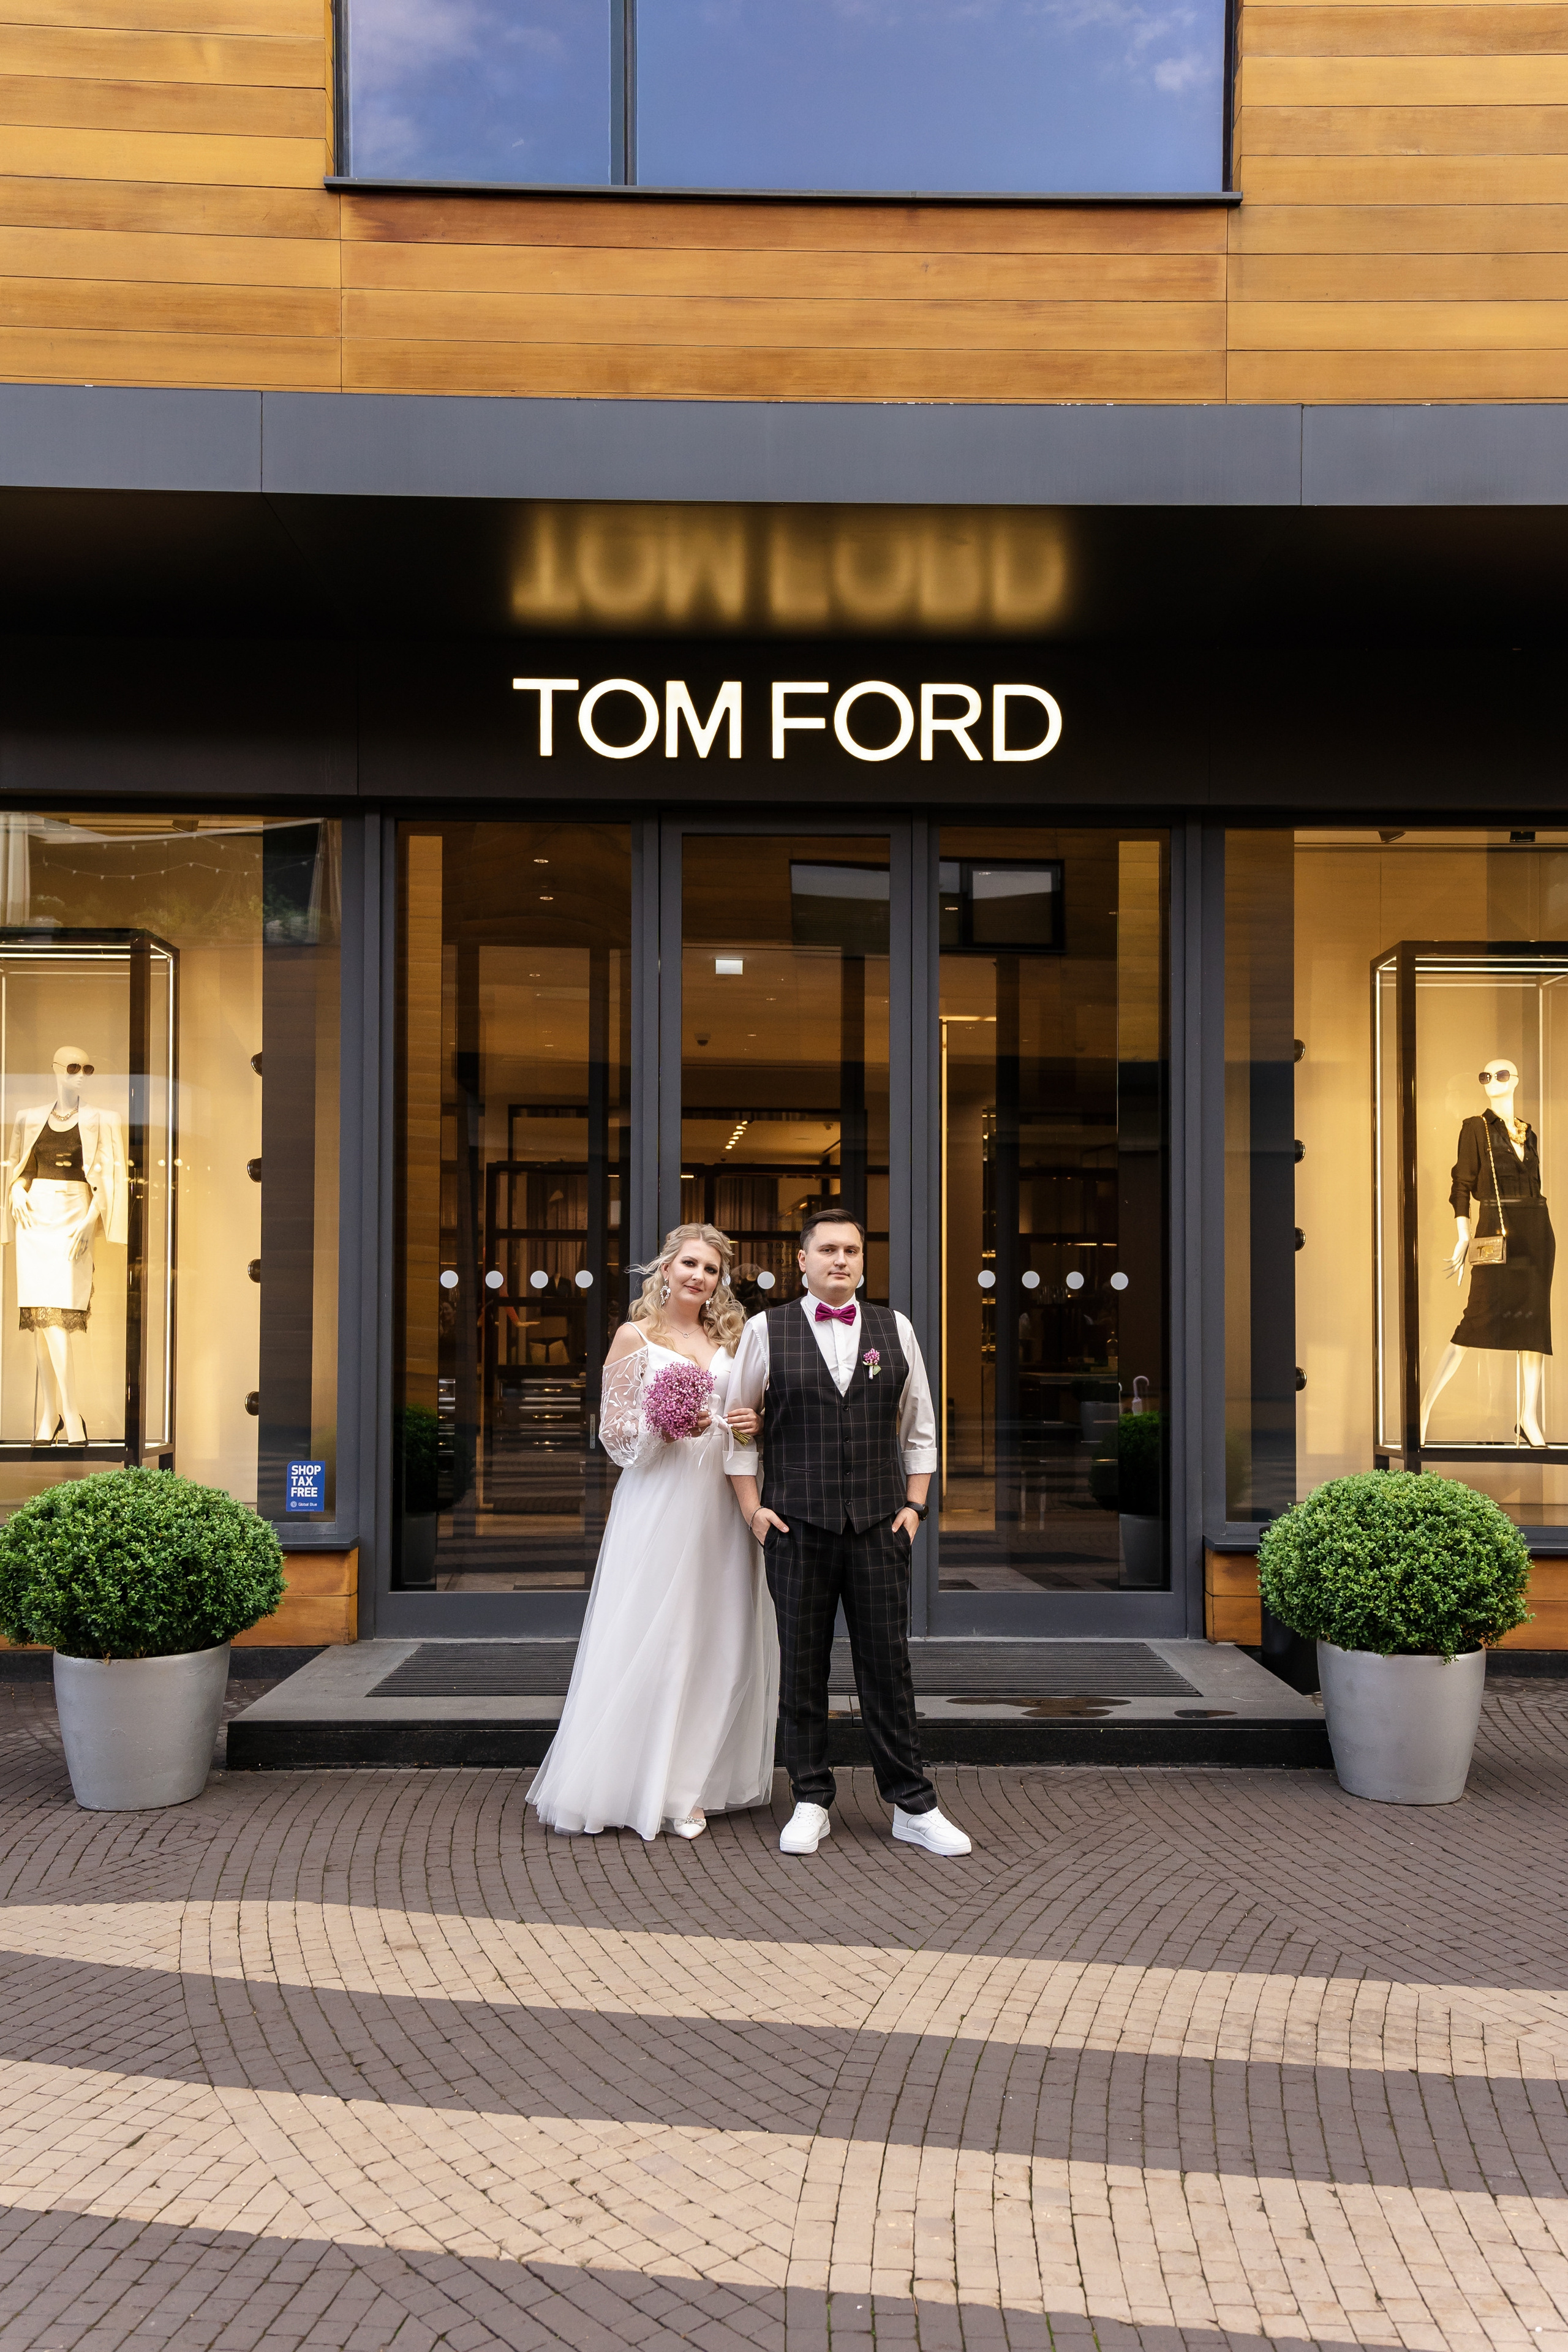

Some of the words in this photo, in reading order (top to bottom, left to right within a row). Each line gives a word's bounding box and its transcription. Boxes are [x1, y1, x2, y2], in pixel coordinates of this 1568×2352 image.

[513, 678, 741, 758] TOM
[772, 680, 1061, 761] FORD
[291, 1464, 322, 1476] SHOP
[290, 1476, 314, 1487] TAX
[290, 1487, 318, 1498] FREE
